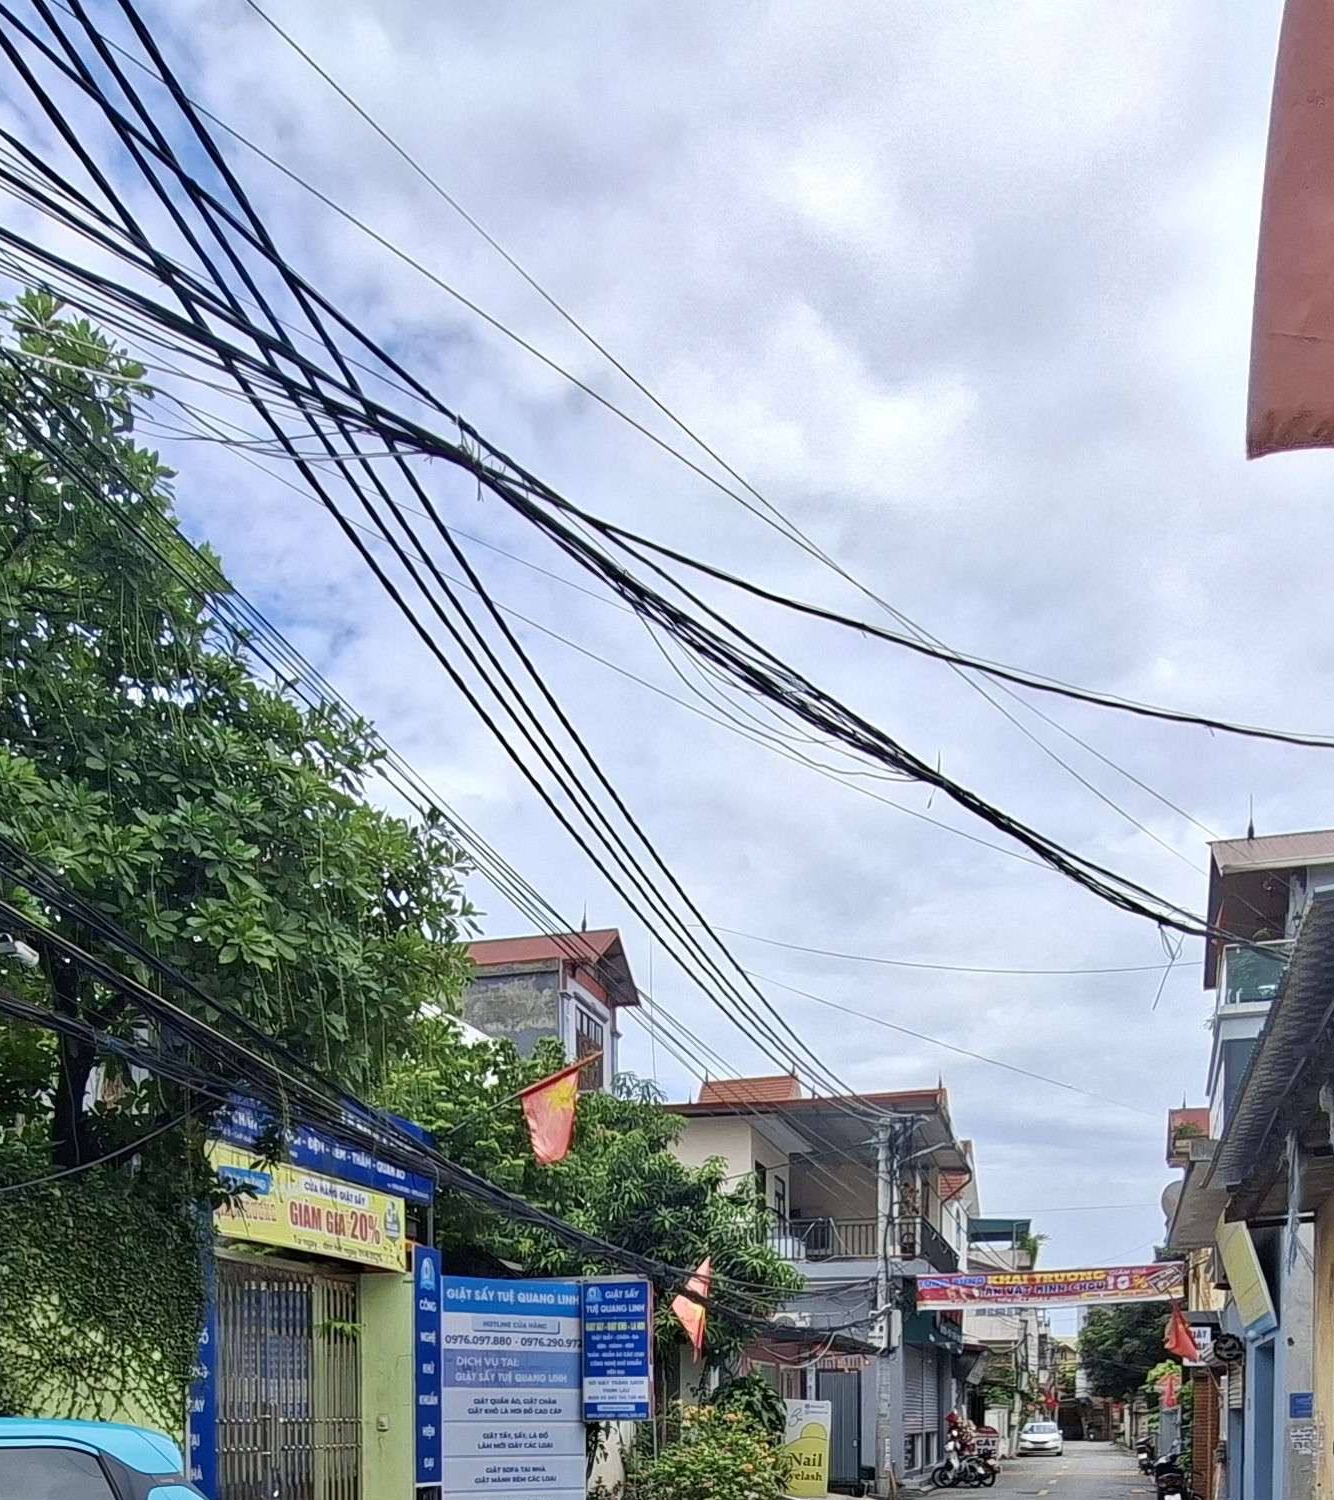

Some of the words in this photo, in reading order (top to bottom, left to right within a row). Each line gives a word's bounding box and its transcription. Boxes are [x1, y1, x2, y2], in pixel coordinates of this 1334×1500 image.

[290, 1199, 322, 1232] GIẢM
[326, 1207, 346, 1238] GIÁ
[350, 1210, 381, 1246] 20%
[987, 1273, 1028, 1286] KHAI
[447, 1286, 472, 1303] GIẶT
[475, 1286, 495, 1302] SẤY
[517, 1292, 555, 1304] QUANG
[557, 1294, 580, 1306] LINH
[444, 1334, 512, 1346] 0976.097.880
[789, 1452, 823, 1468] Nail
